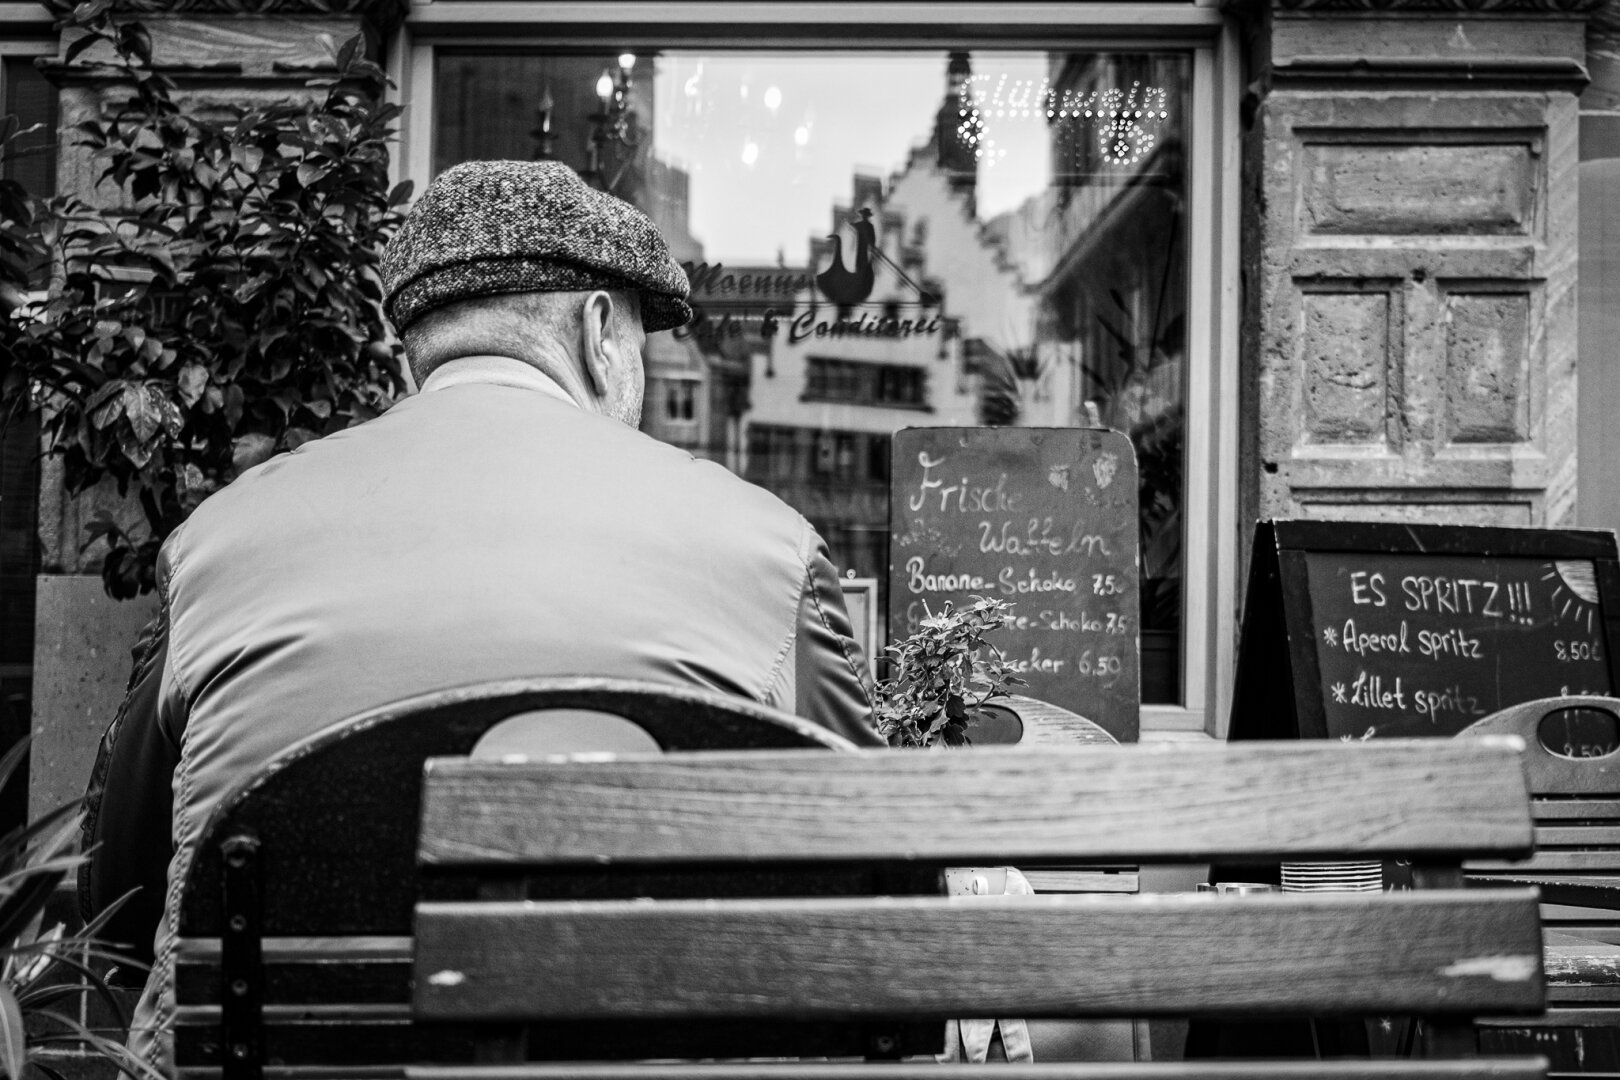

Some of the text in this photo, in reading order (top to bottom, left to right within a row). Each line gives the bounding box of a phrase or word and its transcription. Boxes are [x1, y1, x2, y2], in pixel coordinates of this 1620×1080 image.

[978, 517, 1111, 557] Waffeln
[1350, 571, 1386, 607] ES
[1343, 618, 1411, 657] Aperol
[1351, 670, 1408, 710] Lillet
